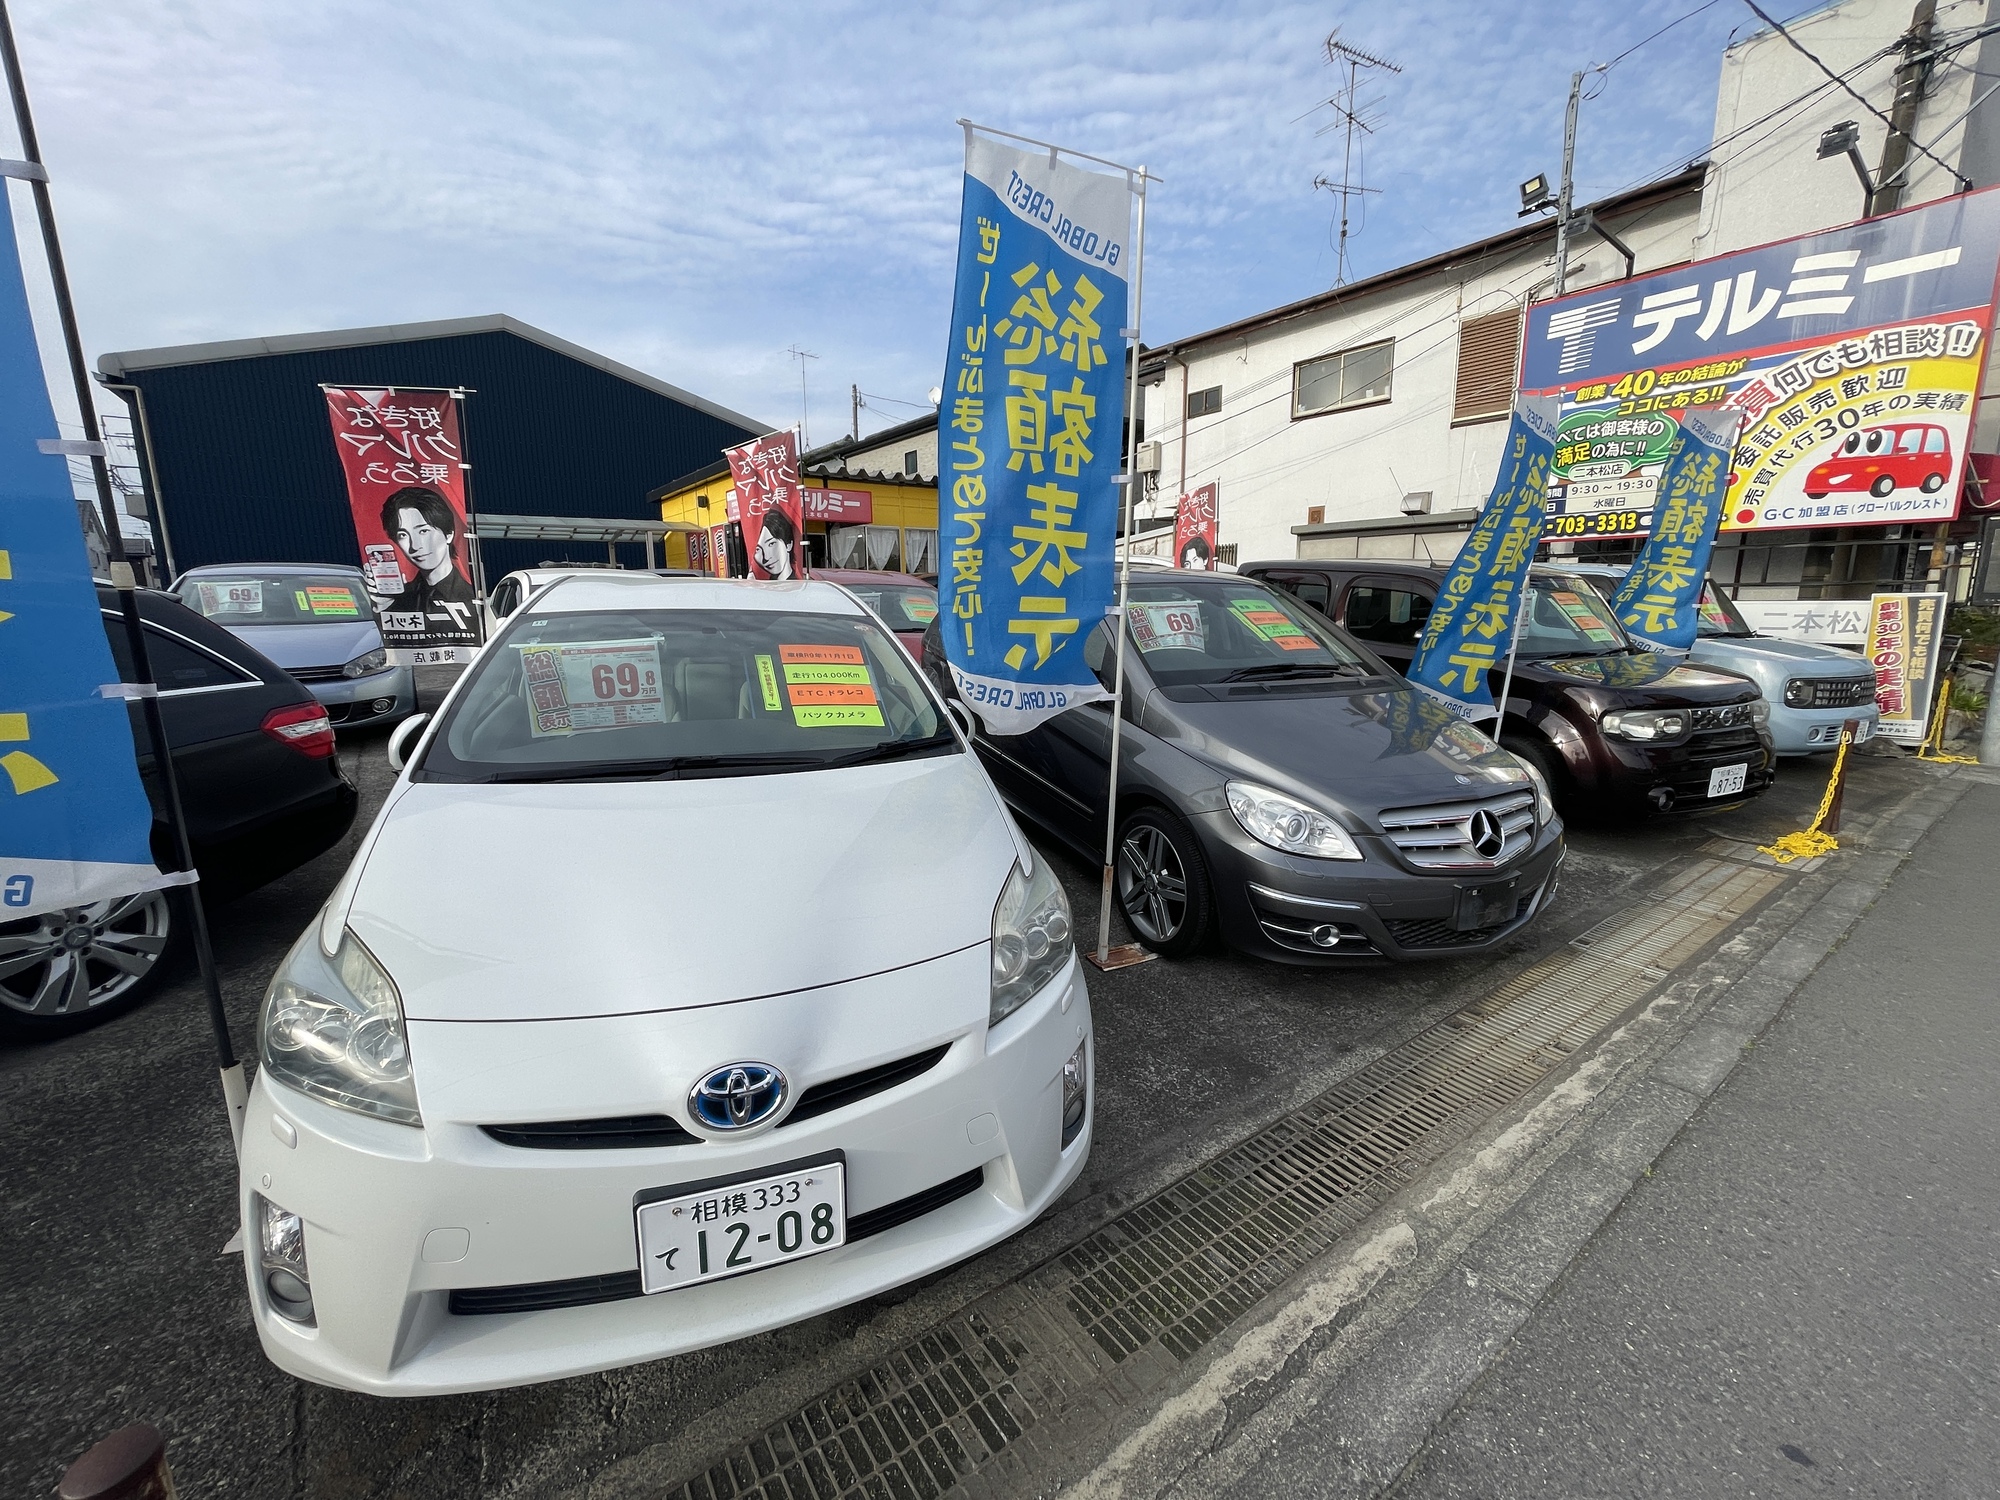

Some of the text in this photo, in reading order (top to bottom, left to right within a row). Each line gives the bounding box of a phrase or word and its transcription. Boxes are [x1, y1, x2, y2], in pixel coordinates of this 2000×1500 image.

[1630, 246, 1963, 356] テルミー
[1733, 327, 1976, 432] 買何でも相談!!
[1617, 386, 1726, 416] ココにある!!
[1732, 367, 1907, 468] 委託販売歓迎
[1743, 392, 1969, 506] 売買代行30年の実績
[1574, 463, 1624, 478] 二本松店
[1571, 483, 1599, 495] 9:30
[1618, 479, 1653, 491] 19:30
[1593, 497, 1626, 508] 水曜日
[1759, 609, 1870, 635] 二本松
[802, 711, 867, 719] バックカメラ
[1717, 776, 1744, 794] 87-53
[691, 1180, 801, 1224] 相模 333
[655, 1202, 835, 1275] て 12-08
